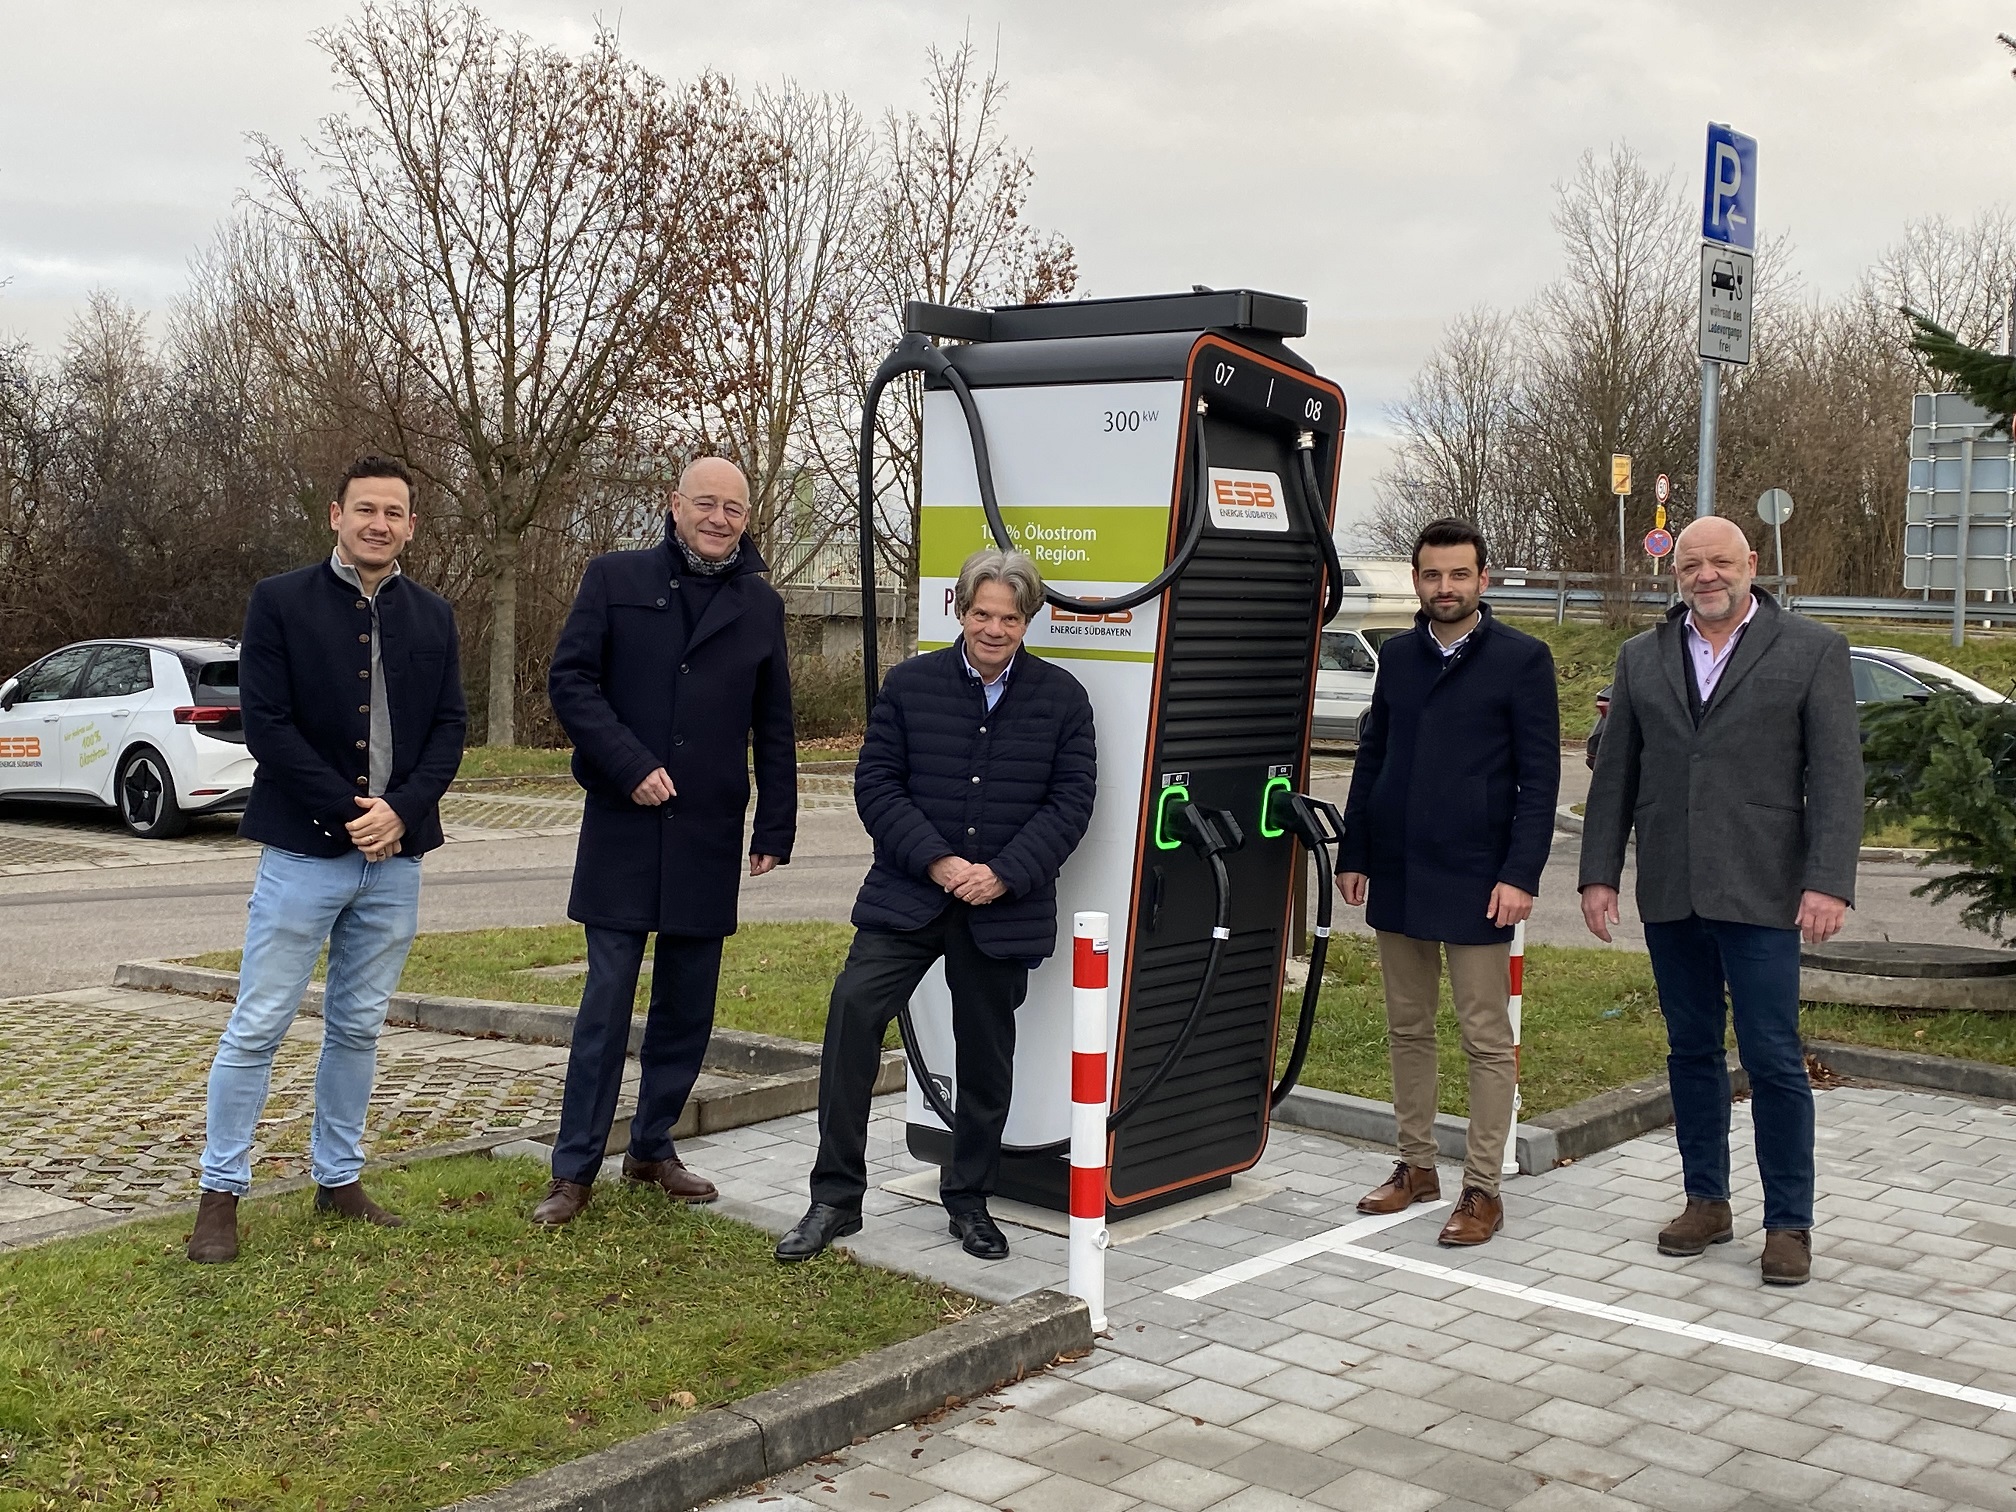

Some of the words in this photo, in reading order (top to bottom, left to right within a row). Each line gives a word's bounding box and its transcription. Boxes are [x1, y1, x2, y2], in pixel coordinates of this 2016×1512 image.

[1711, 141, 1742, 226] P
[1719, 339, 1731, 352] frei
[1215, 362, 1235, 387] 07
[1304, 397, 1323, 422] 08
[1103, 410, 1140, 433] 300
[1142, 410, 1160, 422] kW
[1214, 480, 1275, 508] ESB
[1220, 508, 1244, 518] ENERGIE
[1245, 509, 1278, 520] SÜDBAYERN
[981, 524, 1020, 540] 1%
[1025, 522, 1097, 540] Ökostrom
[1035, 545, 1091, 566] Region.
[1050, 625, 1083, 635] ENERGIE
[1084, 625, 1132, 637] SÜDBAYERN
[0, 737, 41, 757] ESB
